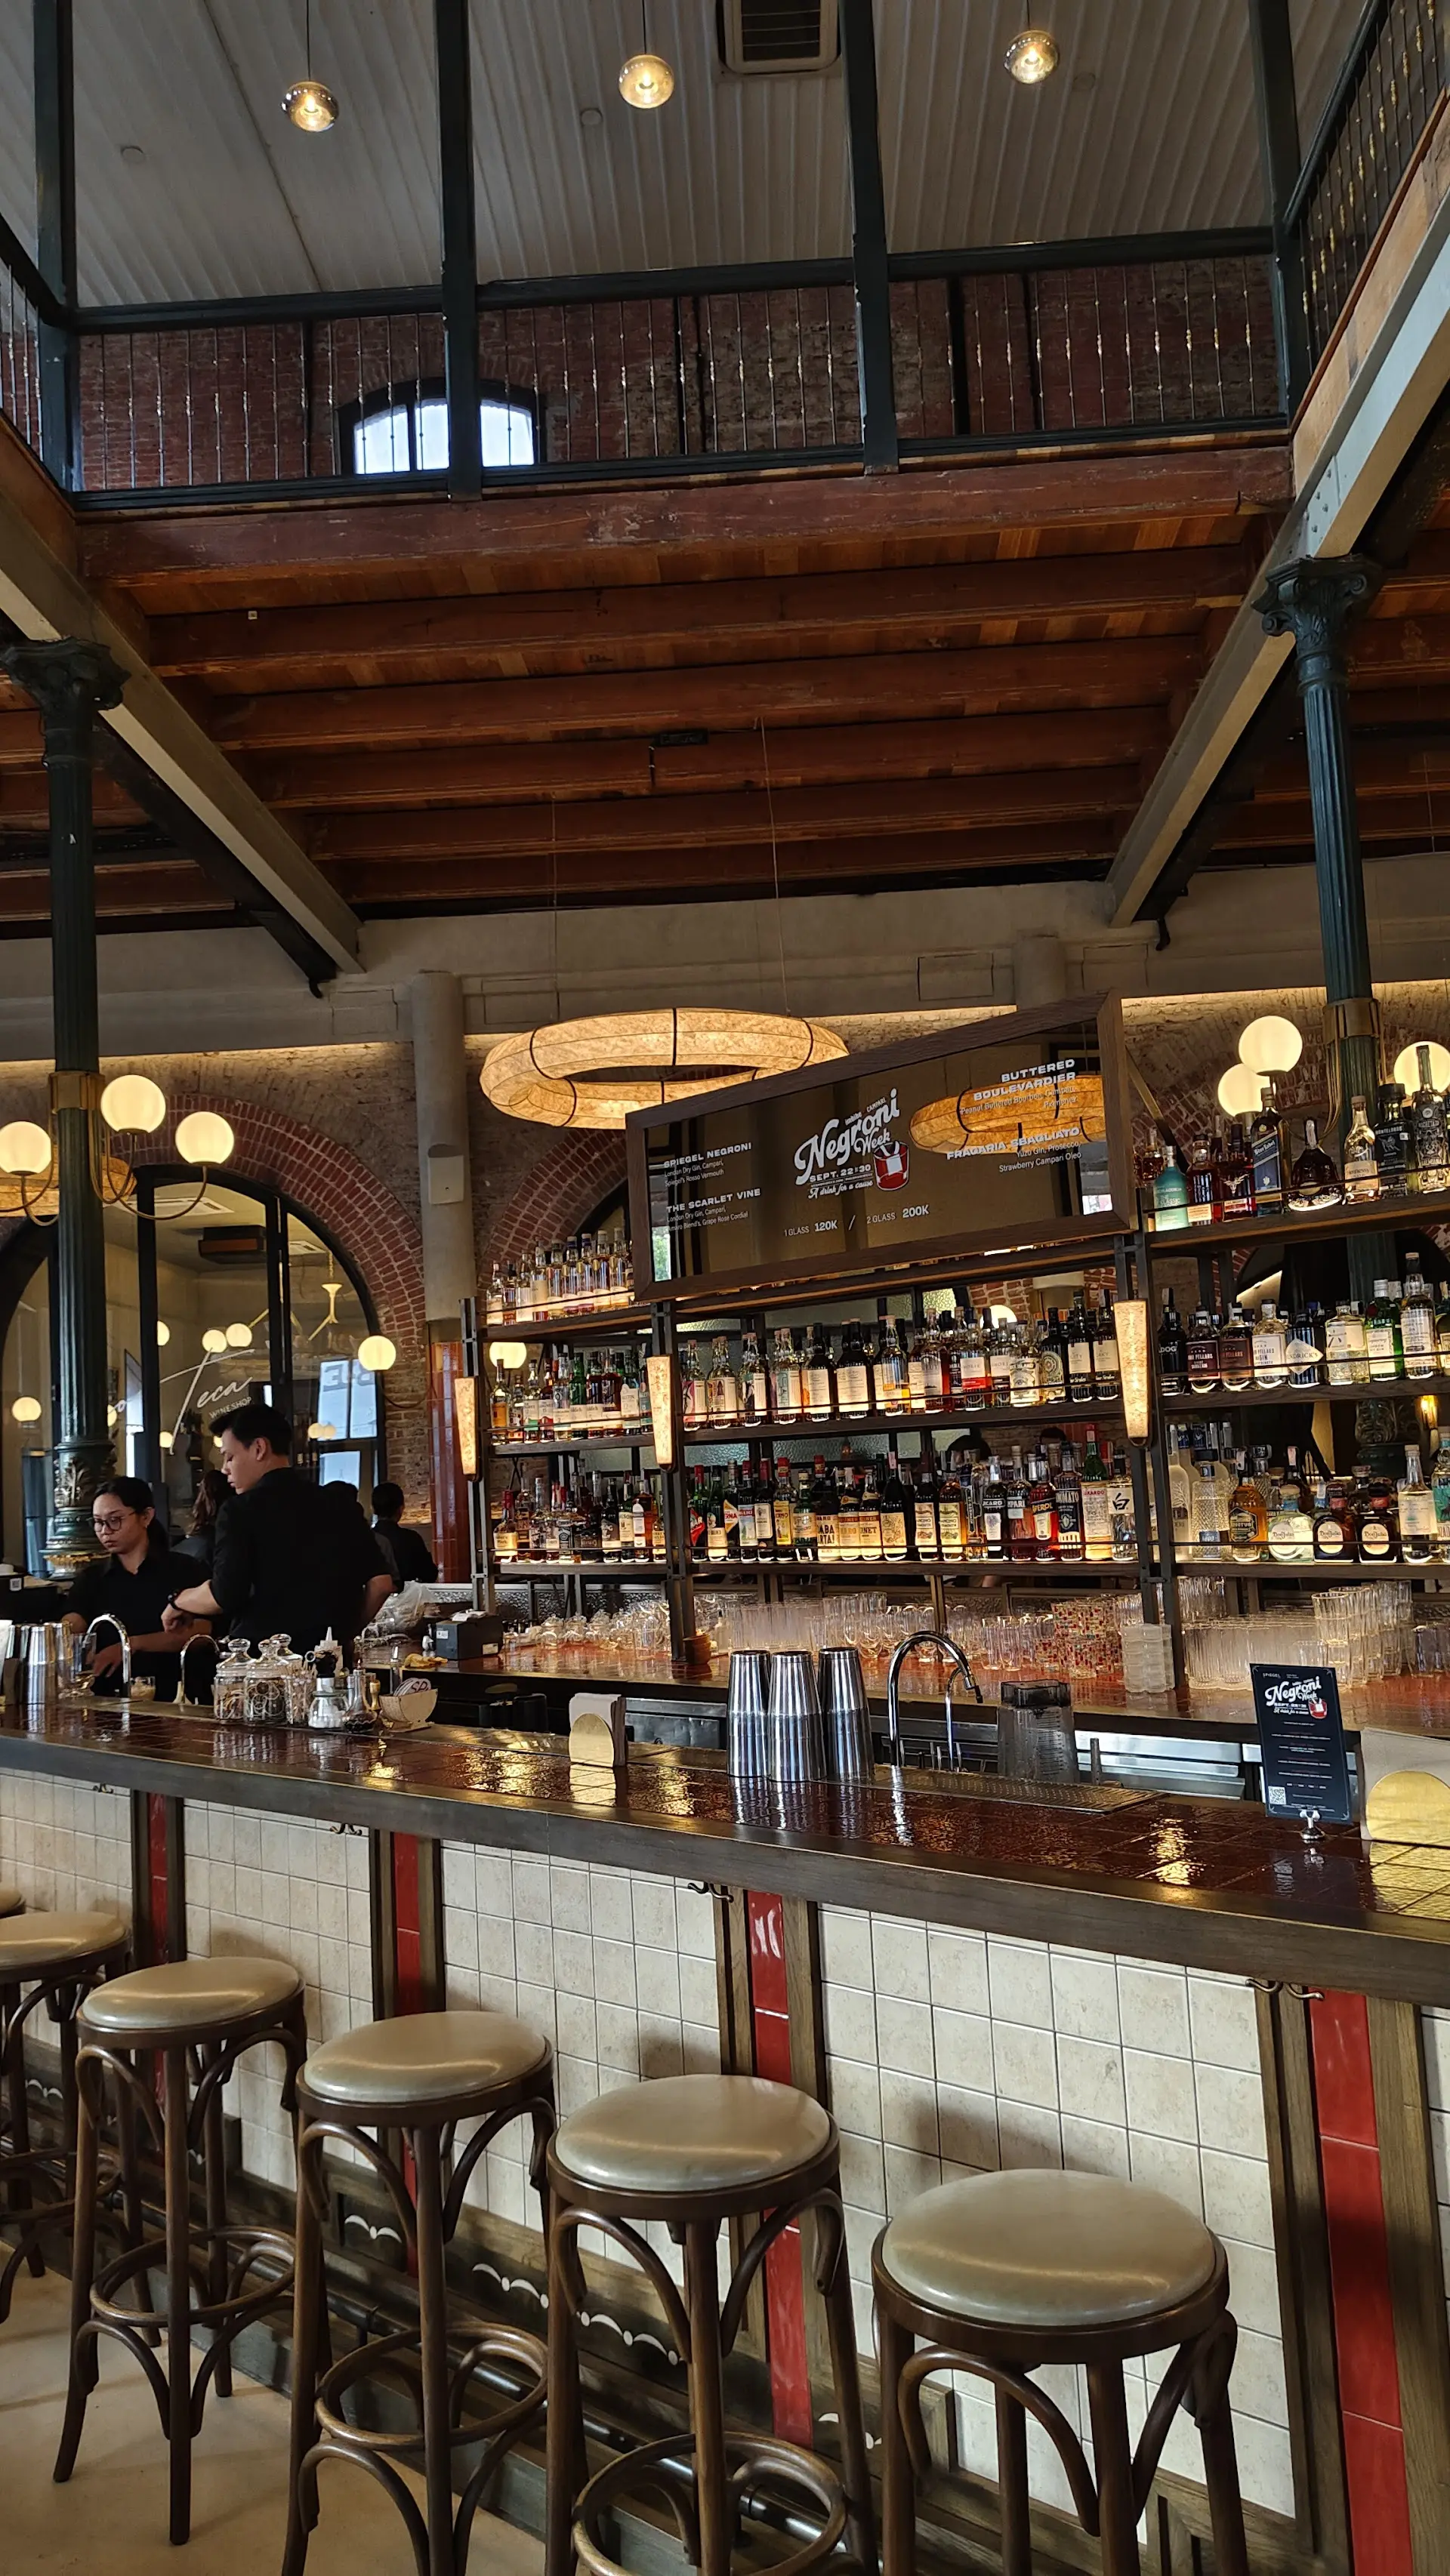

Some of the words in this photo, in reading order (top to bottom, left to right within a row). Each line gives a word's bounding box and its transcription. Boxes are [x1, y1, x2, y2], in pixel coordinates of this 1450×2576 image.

[1001, 1058, 1075, 1083] BUTTERED
[973, 1071, 1076, 1101] BOULEVARDIER
[866, 1097, 887, 1113] CAMPARI
[959, 1105, 983, 1115] Peanut
[984, 1098, 1012, 1109] Buttered
[844, 1111, 862, 1126] imbibe
[794, 1088, 900, 1185] Negroni
[853, 1127, 891, 1156] Week
[946, 1142, 1007, 1160] FRAGARIA
[1010, 1127, 1081, 1148] SBAGLIATO
[663, 1154, 704, 1168] SPIEGEL
[707, 1142, 751, 1158] NEGRONI
[1016, 1149, 1032, 1157] Yuzu
[1033, 1147, 1047, 1156] Gin,
[1047, 1141, 1081, 1152] Prosecco,
[665, 1168, 682, 1177] London
[702, 1159, 723, 1169] Campari,
[998, 1160, 1035, 1172] Strawberry
[1035, 1155, 1064, 1167] Campari
[1065, 1151, 1082, 1160] Oleo
[665, 1178, 685, 1188] Spiegel's
[702, 1169, 724, 1179] Vermouth
[810, 1170, 839, 1183] SEPT.
[840, 1167, 853, 1176] 22
[859, 1163, 871, 1173] 30
[808, 1187, 819, 1199] A
[820, 1185, 836, 1196] drink
[835, 1183, 847, 1196] for
[855, 1180, 874, 1189] cause
[666, 1203, 685, 1213] THE
[688, 1194, 733, 1209] SCARLET
[736, 1188, 760, 1200] VINE
[667, 1213, 684, 1223] London
[685, 1211, 693, 1219] Dry
[705, 1205, 727, 1215] Campari,
[702, 1218, 717, 1226] Grape
[730, 1211, 748, 1221] Cordial
[788, 1225, 810, 1236] GLASS
[814, 1219, 838, 1232] 120K
[872, 1213, 896, 1224] GLASS
[902, 1204, 929, 1219] 200K
[159, 1347, 255, 1456] Teca
[1112, 1493, 1130, 1510] 白
[1265, 1676, 1322, 1706] Negroni
[1297, 1691, 1318, 1701] Week
